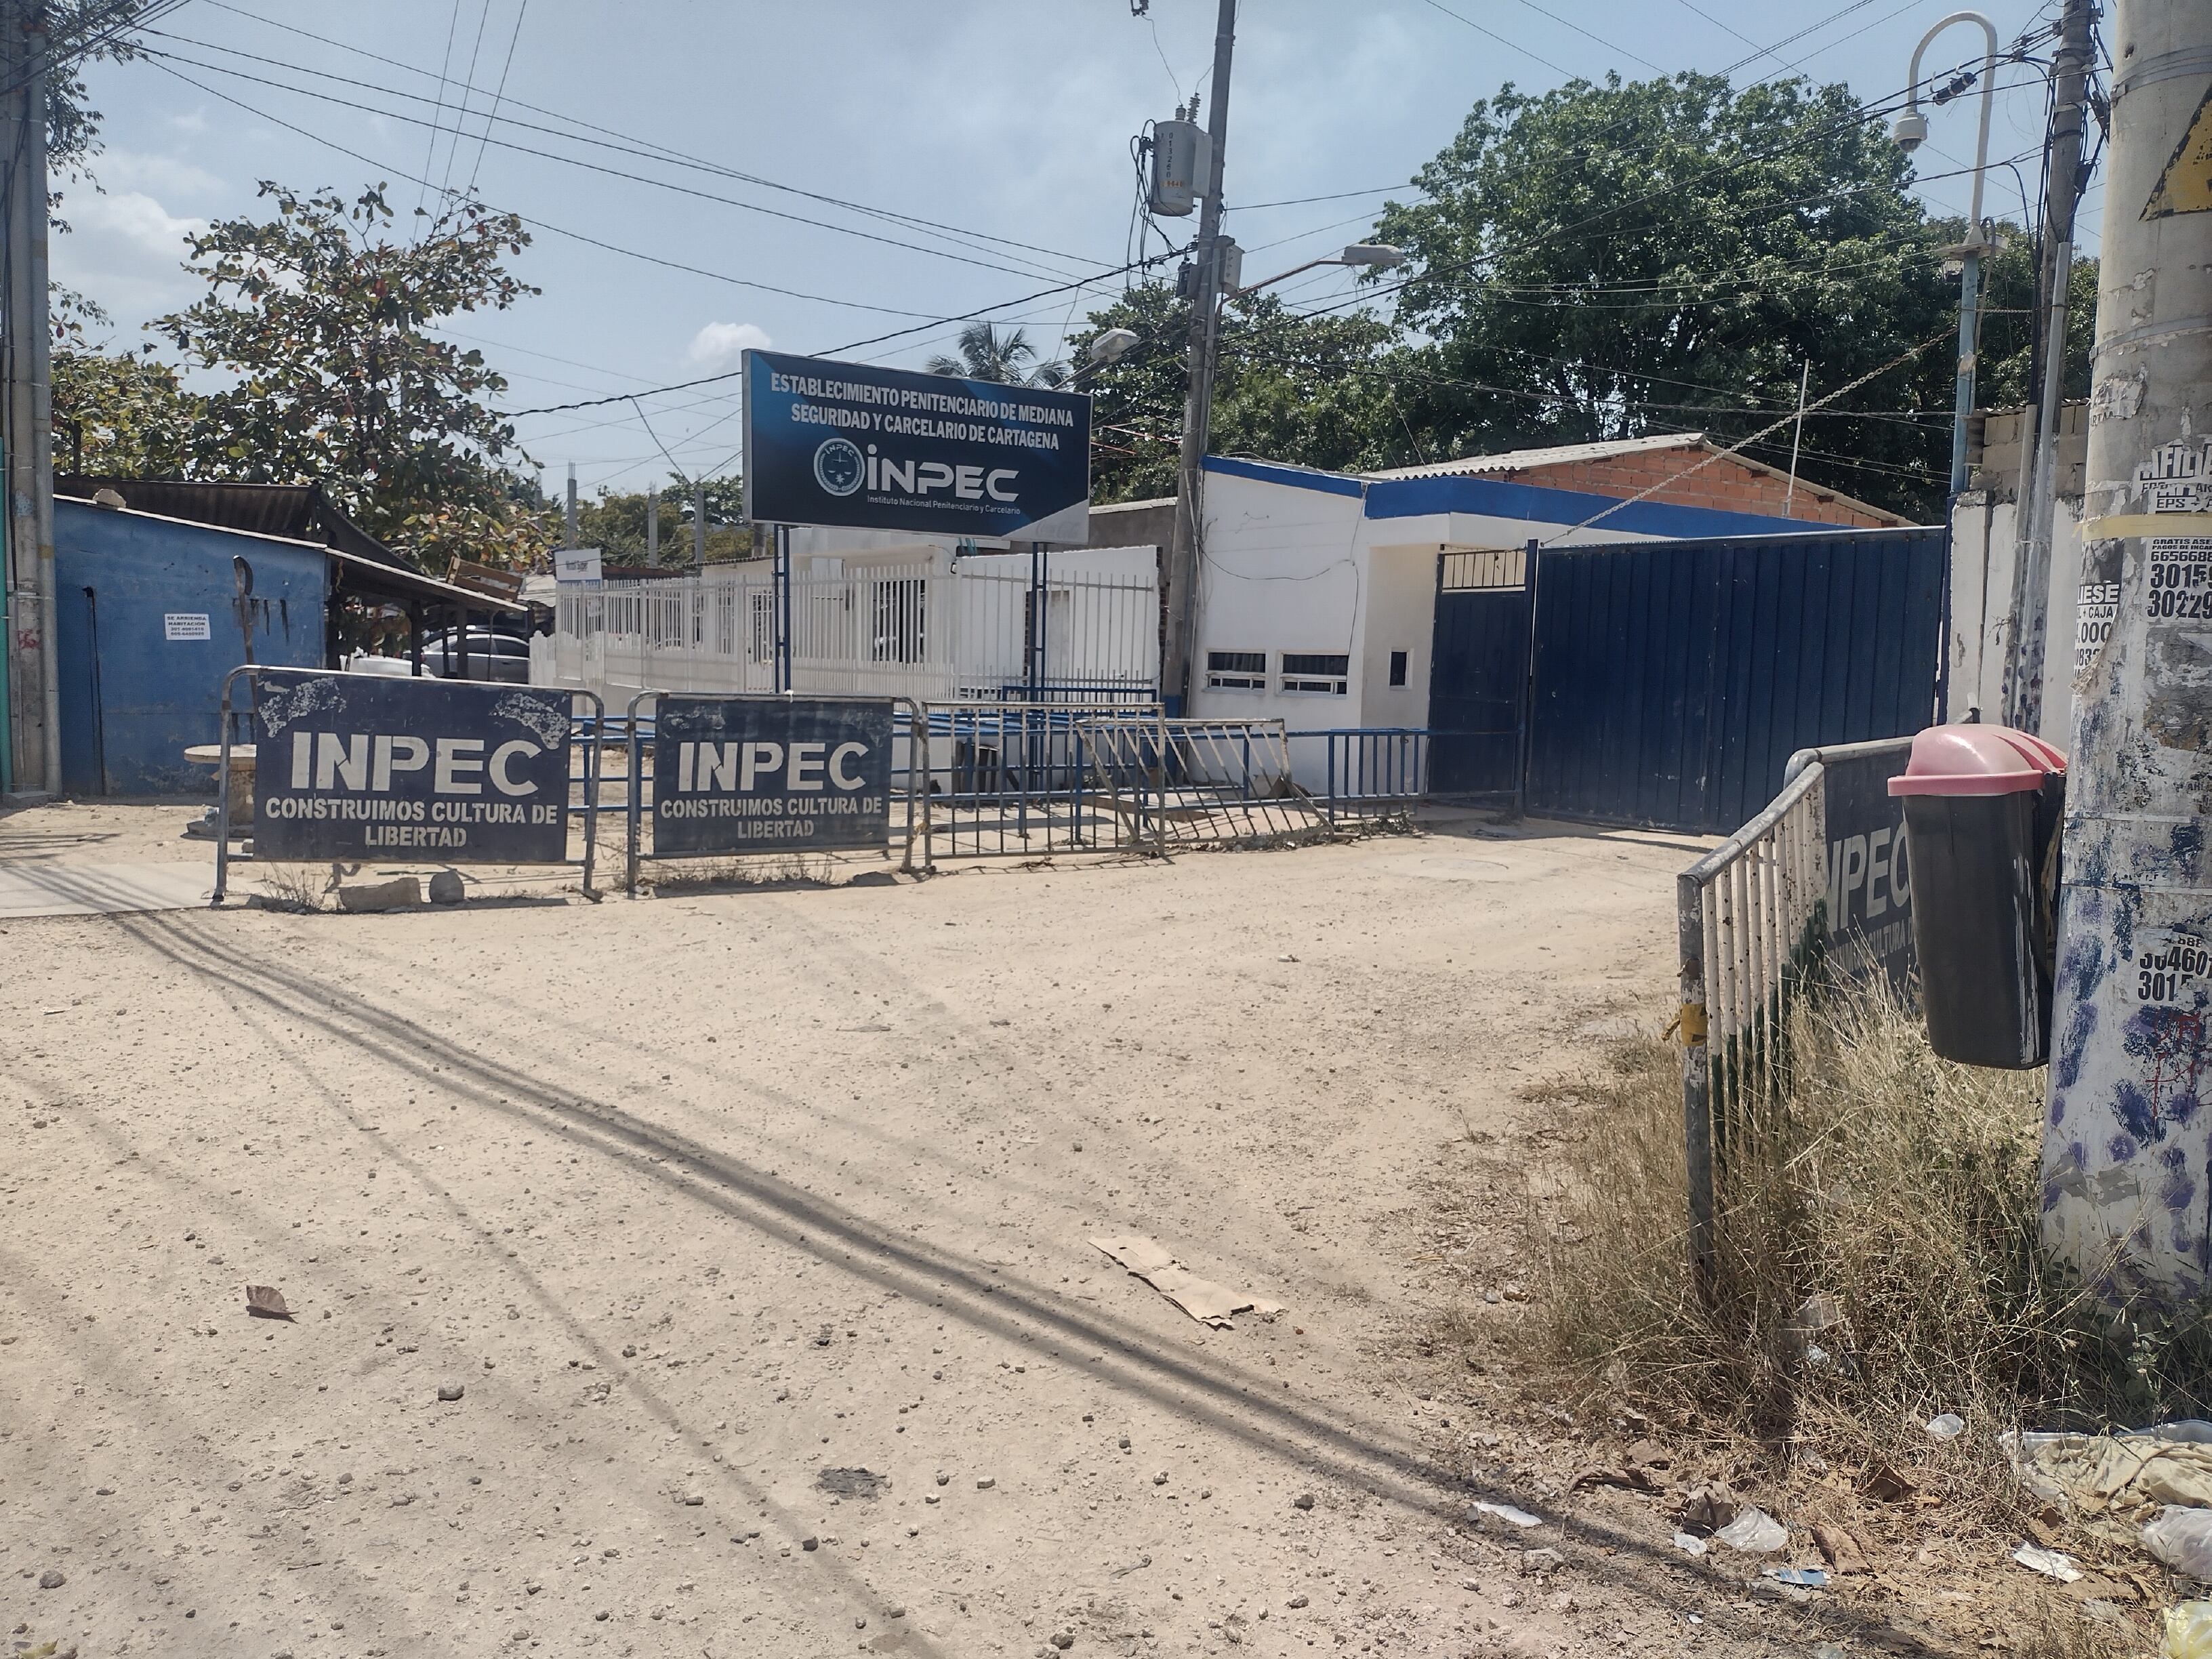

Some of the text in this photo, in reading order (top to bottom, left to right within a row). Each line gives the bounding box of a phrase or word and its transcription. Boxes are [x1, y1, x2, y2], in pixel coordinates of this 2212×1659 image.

[771, 372, 1074, 427] ESTABLECIMIENTO PENITENCIARIO DE MEDIANA
[791, 403, 1059, 451] SEGURIDAD Y CARCELARIO DE CARTAGENA
[867, 495, 899, 505] Instituto
[899, 498, 932, 508] Nacional
[933, 500, 979, 512] Penitenciario
[985, 505, 1021, 515] Carcelario
[2156, 498, 2186, 508] EPS
[2088, 606, 2113, 619] CAJA
[291, 731, 542, 796] INPEC
[678, 741, 869, 792] INPEC
[265, 797, 558, 825] CONSTRUIMOS CULTURA DE
[661, 796, 882, 819] CONSTRUIMOS CULTURA DE
[365, 825, 467, 848] LIBERTAD
[737, 819, 815, 840] LIBERTAD
